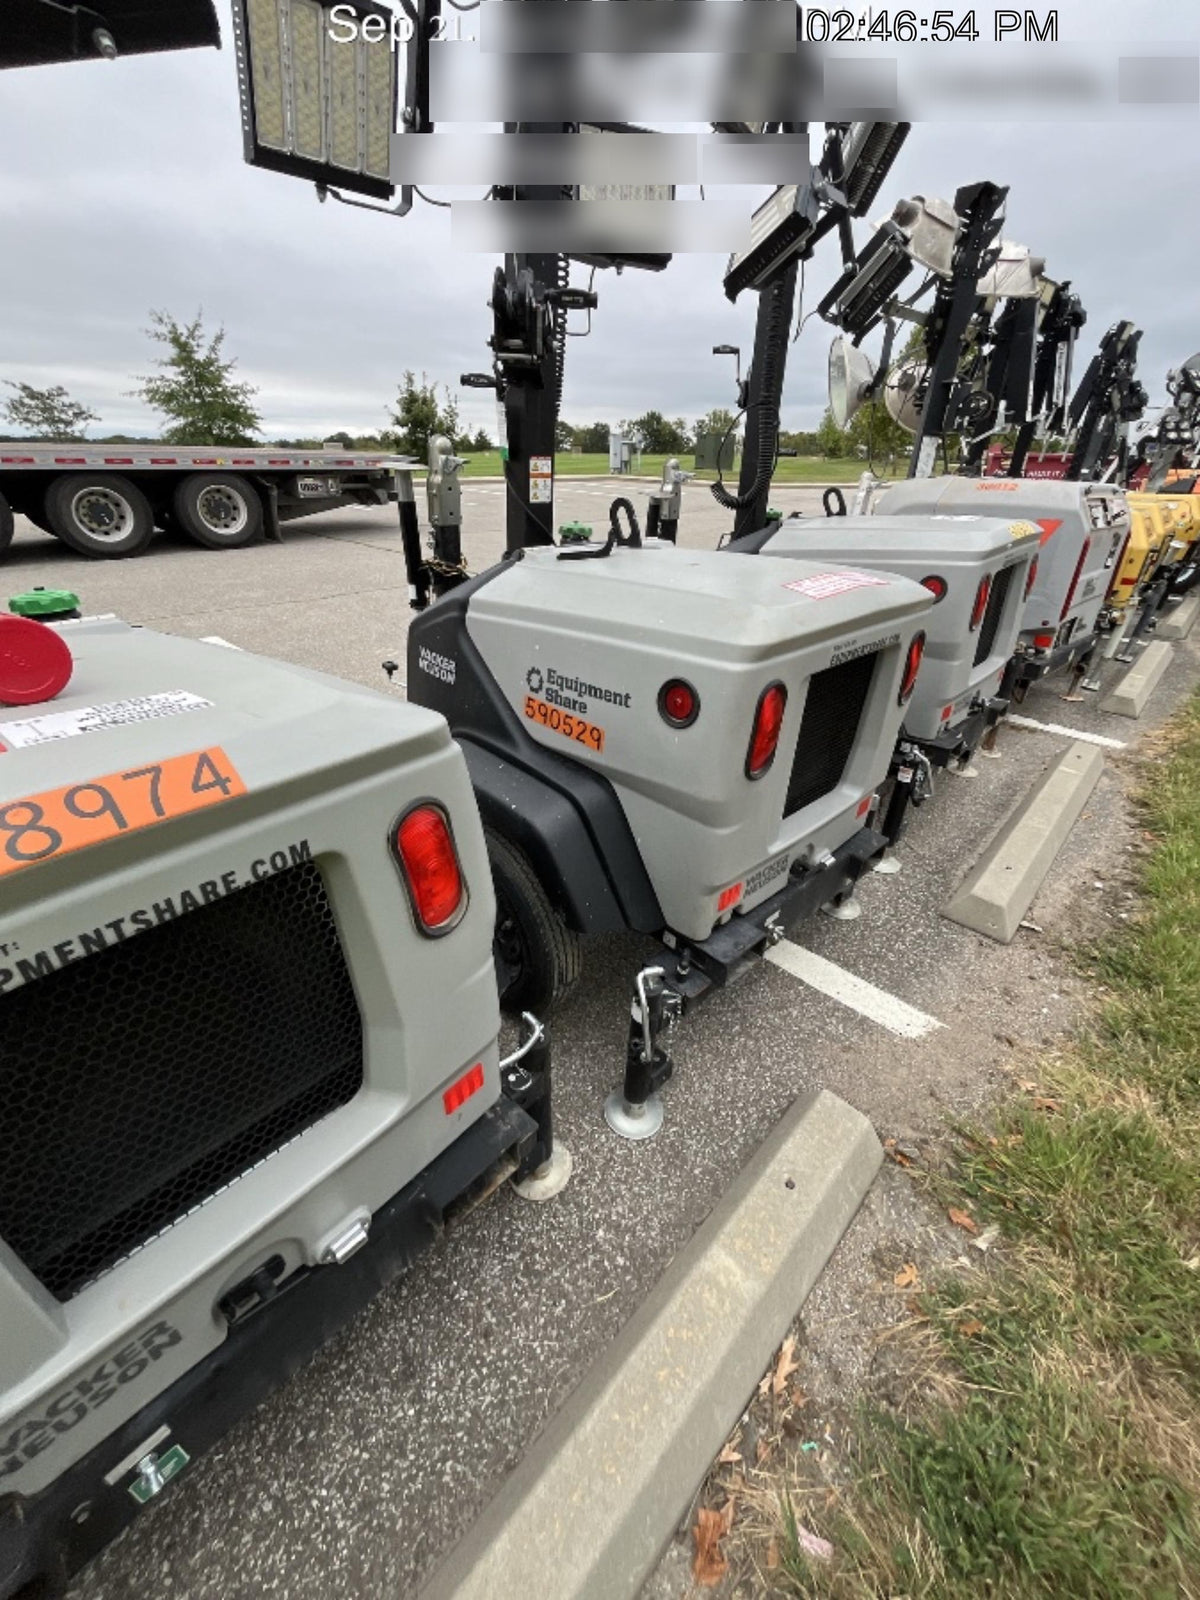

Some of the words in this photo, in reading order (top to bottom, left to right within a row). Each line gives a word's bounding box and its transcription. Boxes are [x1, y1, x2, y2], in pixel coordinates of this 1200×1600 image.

[545, 687, 588, 714] Share
[546, 668, 632, 708] Equipment
[525, 697, 602, 750] 590529
[0, 752, 231, 861] 8974
